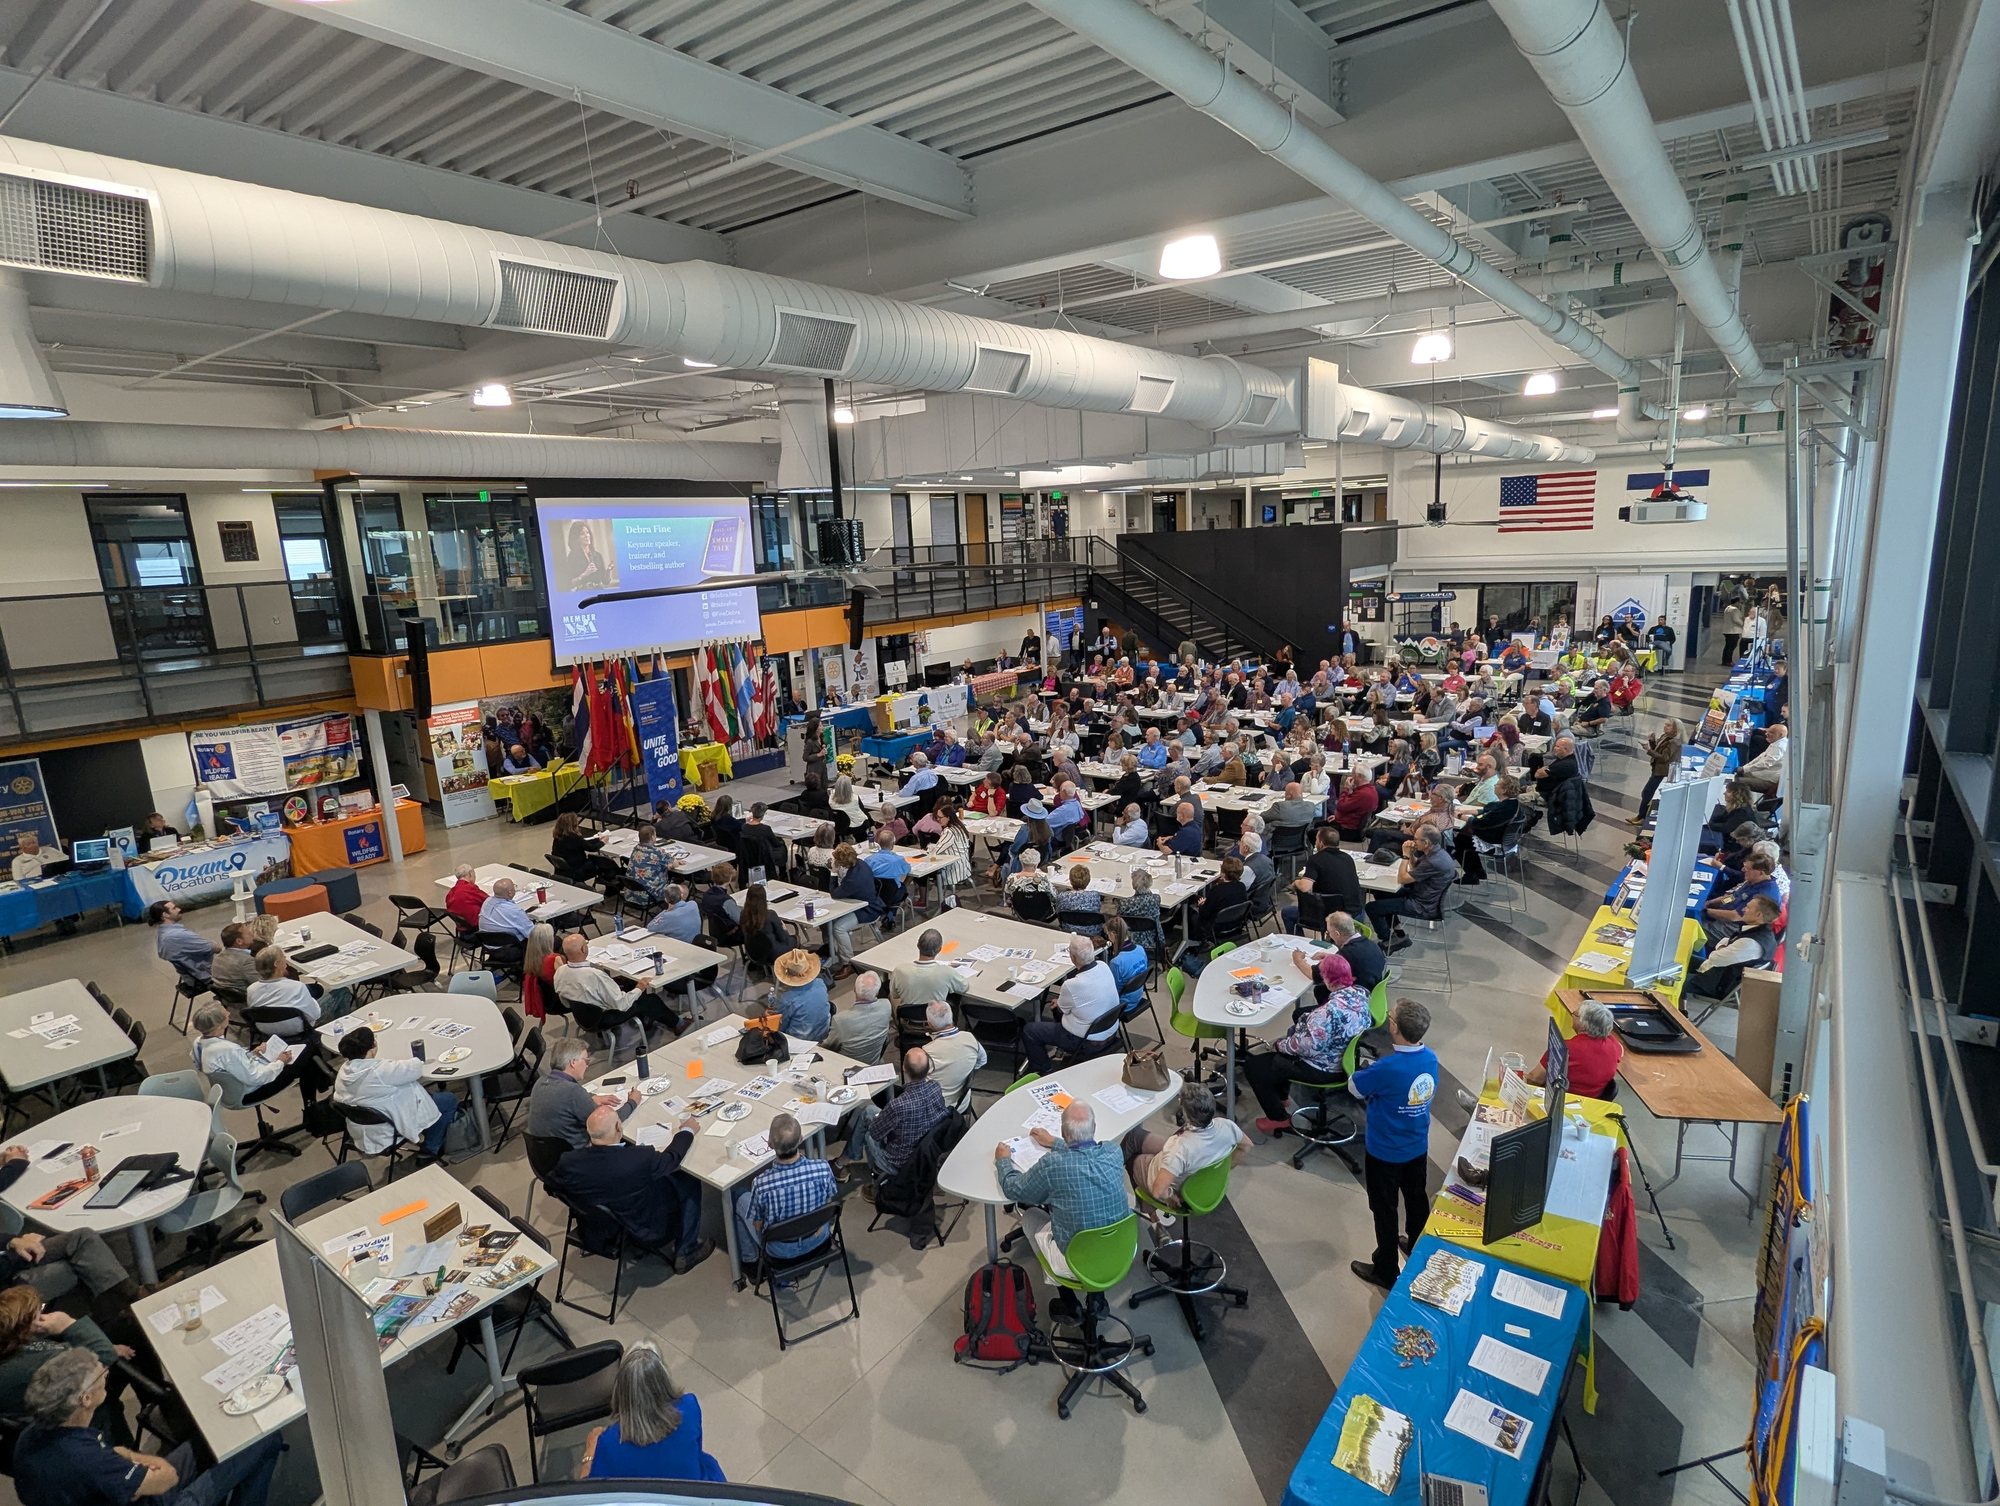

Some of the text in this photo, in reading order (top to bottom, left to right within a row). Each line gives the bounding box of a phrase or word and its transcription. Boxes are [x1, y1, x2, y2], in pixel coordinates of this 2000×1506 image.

[625, 525, 672, 534] Debra Fine
[627, 540, 681, 550] Keynote speaker,
[628, 552, 652, 560] trainer,
[629, 561, 685, 572] bestselling author
[563, 613, 596, 623] MEMBER
[204, 729, 219, 738] YOU
[219, 728, 250, 738] WILDFIRE
[250, 725, 275, 734] READY?
[643, 735, 667, 750] UNITE
[653, 744, 669, 758] FOR
[657, 752, 678, 768] GOOD
[347, 828, 365, 836] Rotary
[351, 845, 380, 857] WILDFIRE
[356, 852, 377, 863] READY
[154, 857, 234, 886] Dream
[161, 871, 230, 893] Vacations
[738, 1088, 761, 1099] WASH
[1031, 1082, 1059, 1095] IMPACT
[351, 1235, 391, 1252] IMPACT
